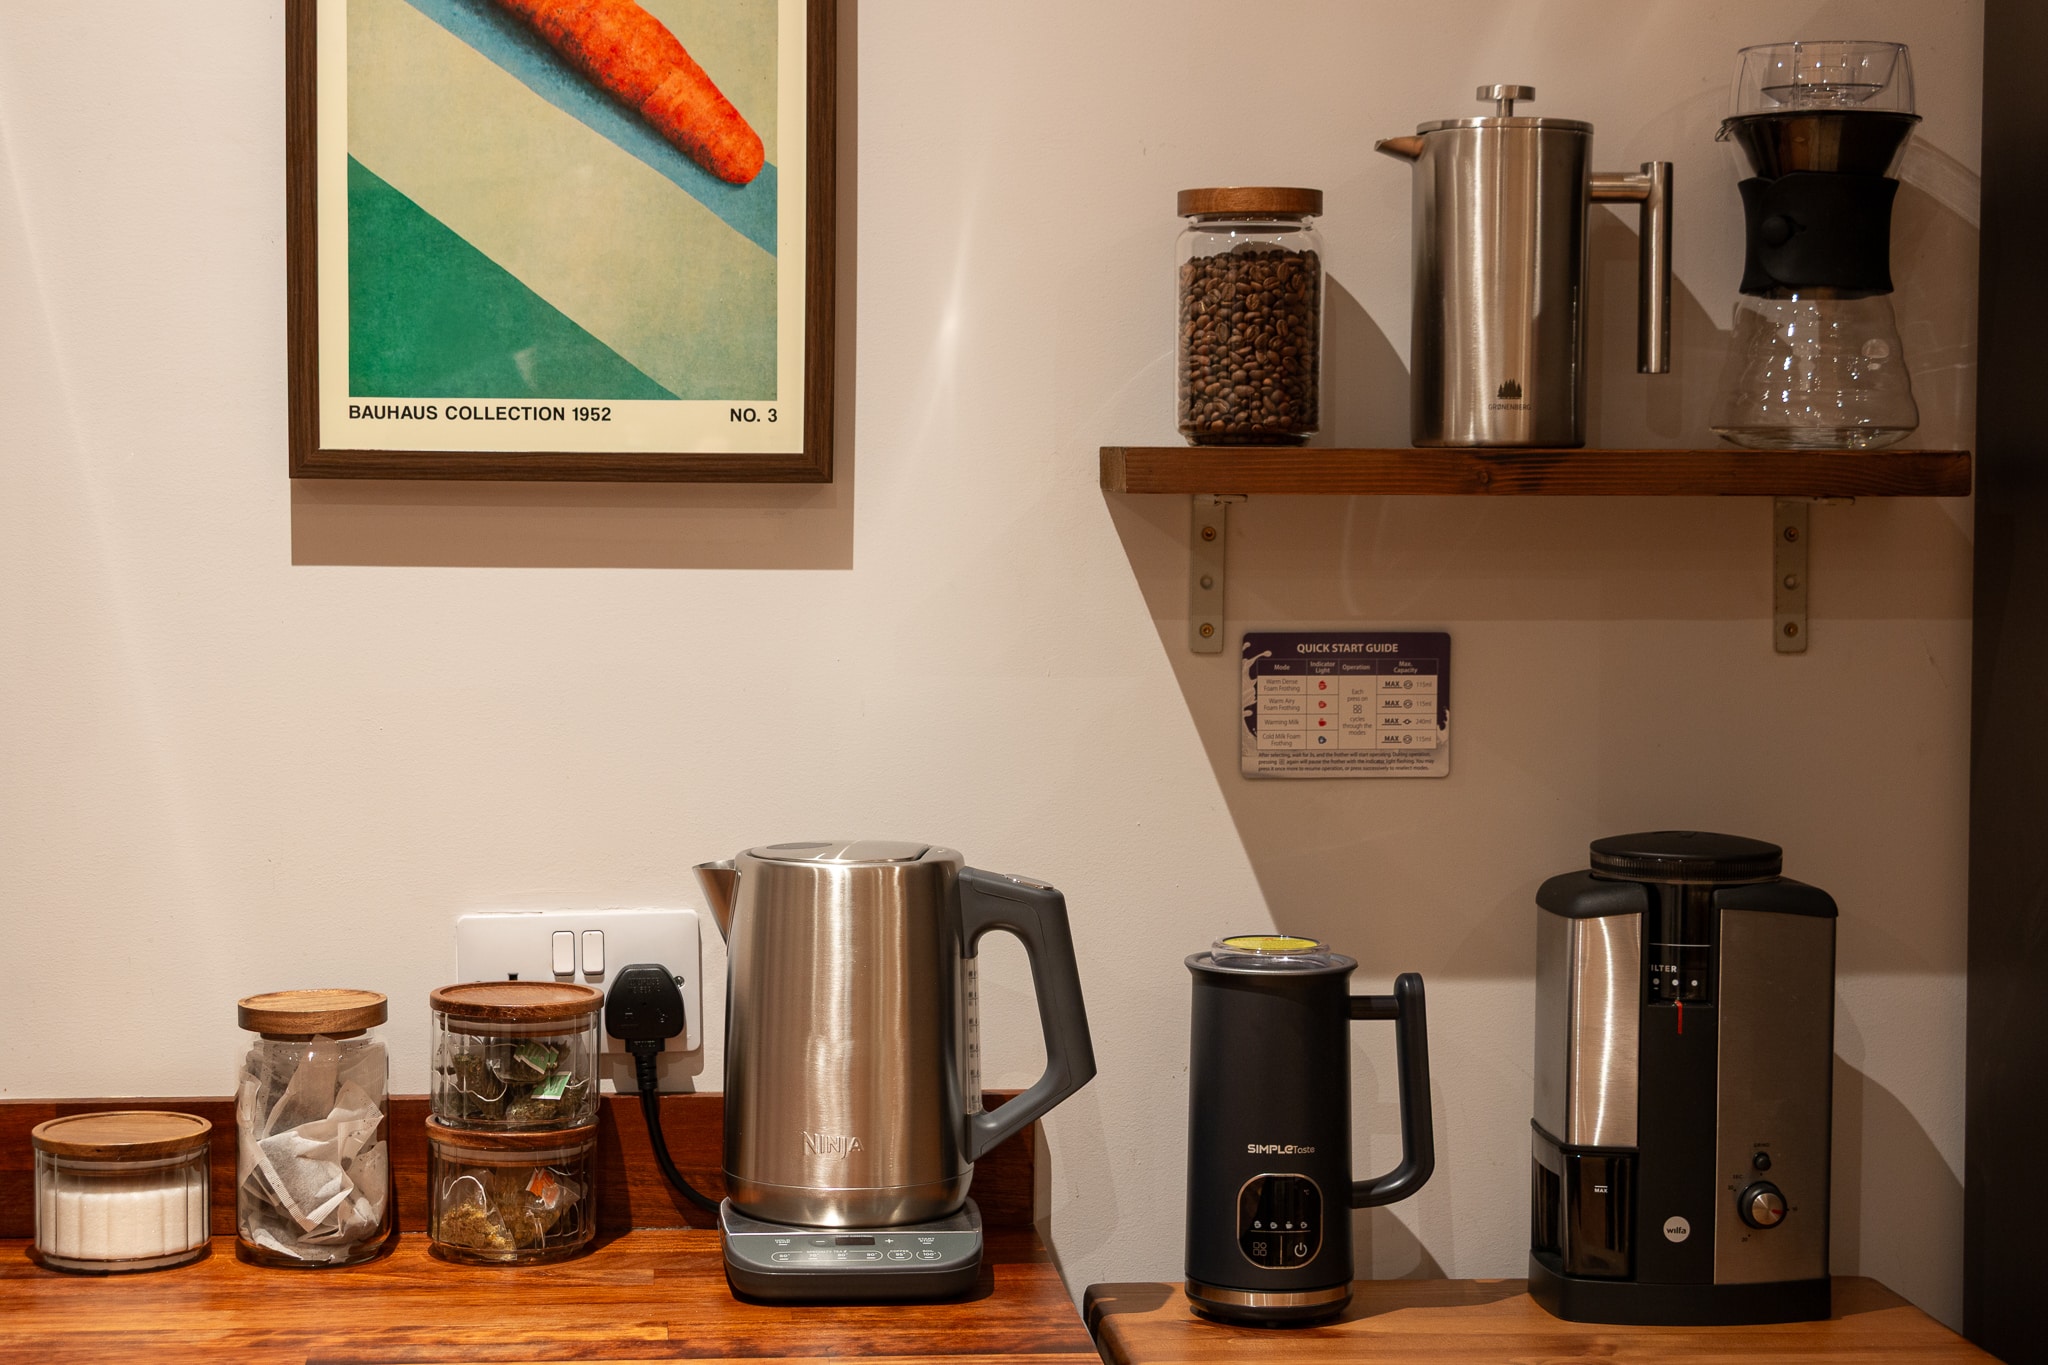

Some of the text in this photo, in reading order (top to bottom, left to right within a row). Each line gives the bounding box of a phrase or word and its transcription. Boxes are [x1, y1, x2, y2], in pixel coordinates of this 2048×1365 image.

[348, 405, 778, 423] BAUHAUS COLLECTION 1952 NO. 3
[1297, 644, 1398, 653] QUICK START GUIDE
[1650, 964, 1677, 972] ILTER
[802, 1132, 864, 1159] NINJA
